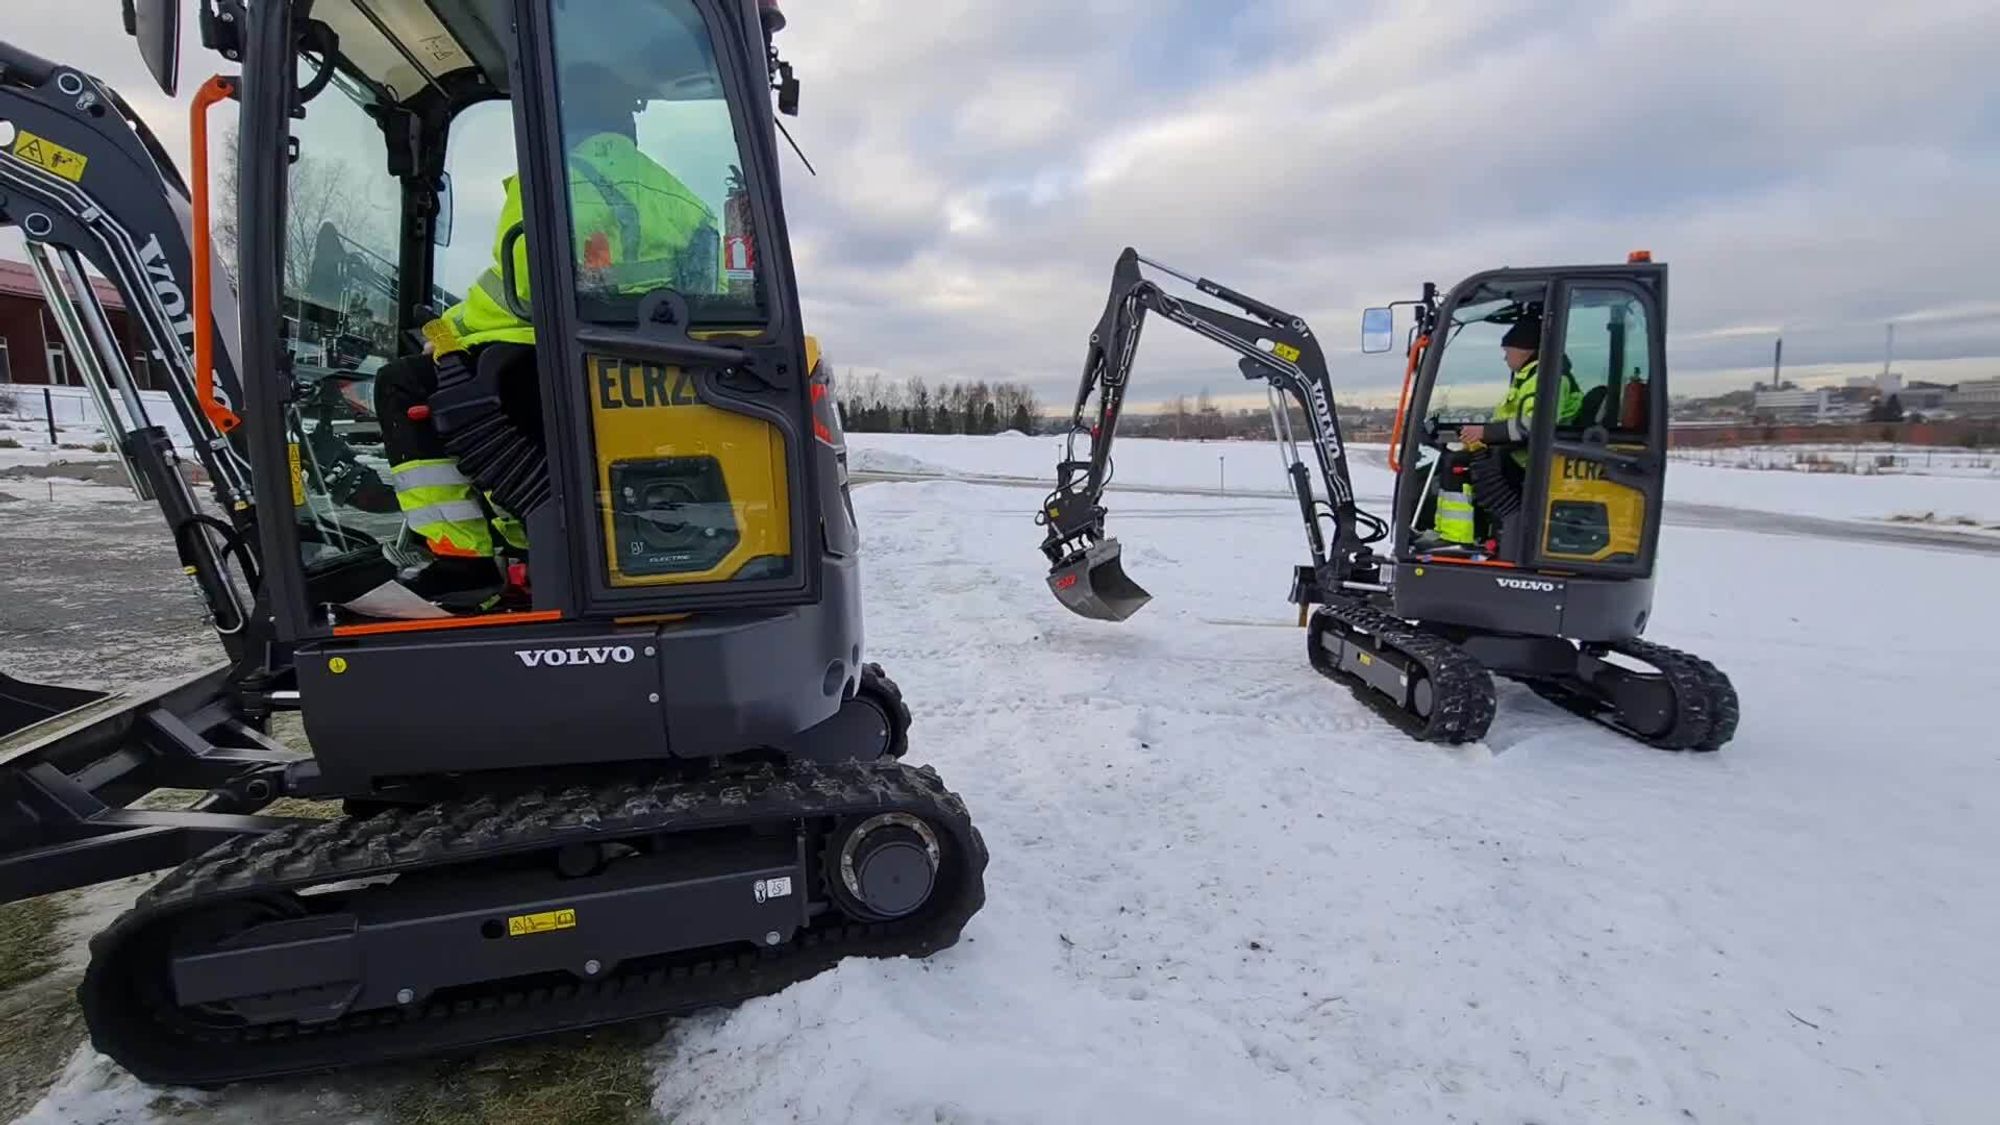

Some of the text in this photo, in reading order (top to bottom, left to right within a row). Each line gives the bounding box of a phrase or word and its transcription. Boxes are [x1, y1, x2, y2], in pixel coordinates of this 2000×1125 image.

[1312, 377, 1341, 460] VOLVO
[649, 554, 691, 563] ELECTRIC
[1496, 577, 1554, 592] VOLVO
[514, 645, 635, 667] VOLVO
